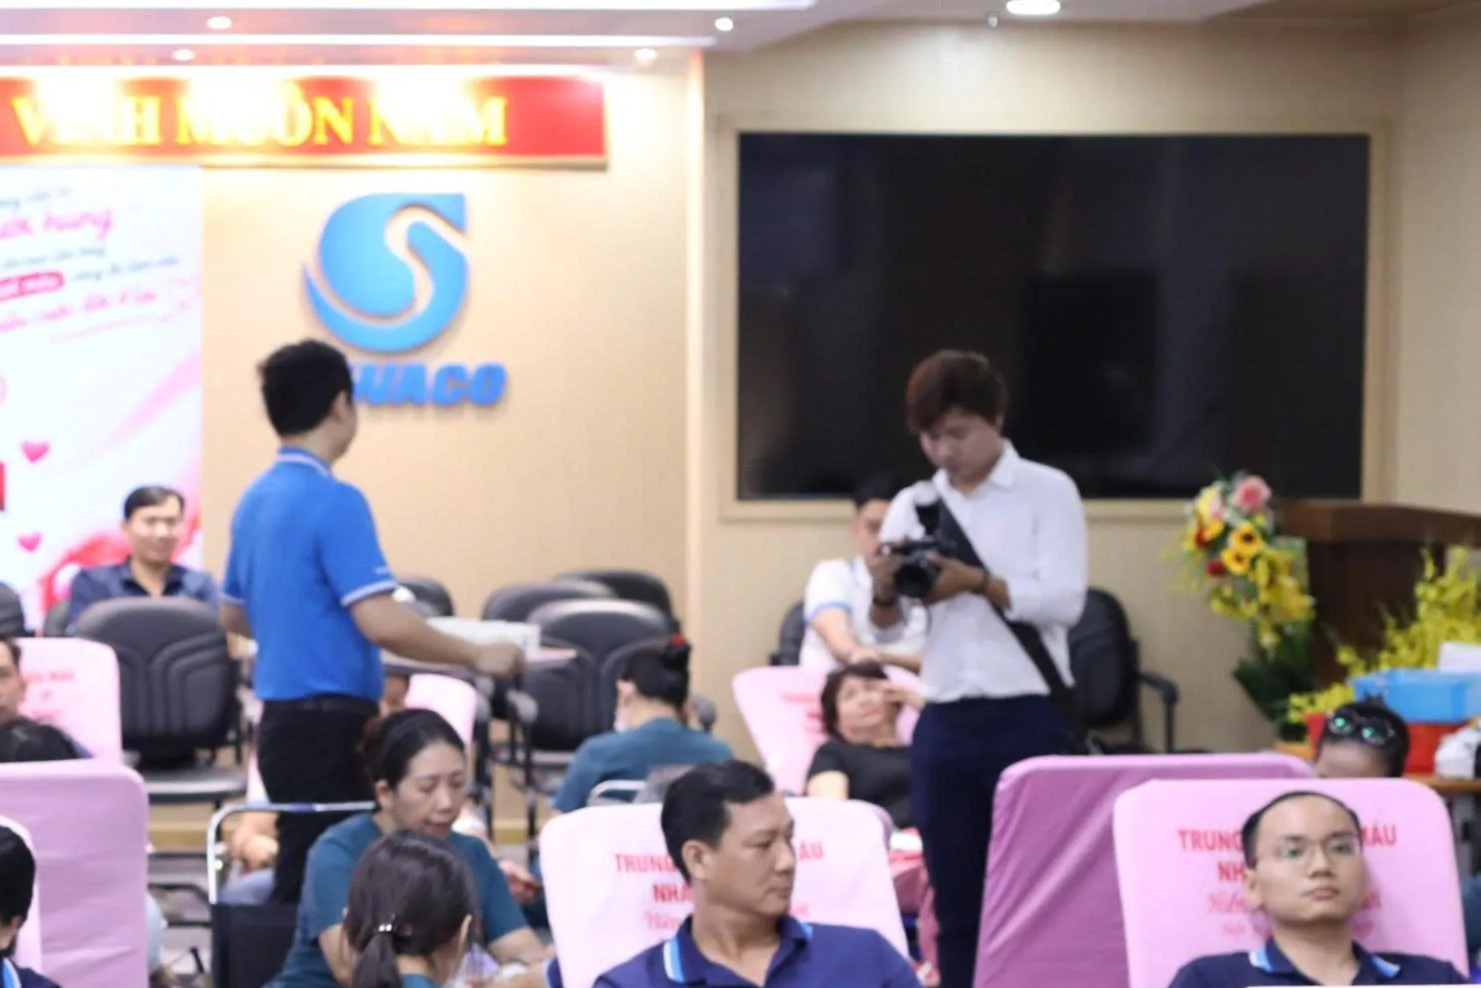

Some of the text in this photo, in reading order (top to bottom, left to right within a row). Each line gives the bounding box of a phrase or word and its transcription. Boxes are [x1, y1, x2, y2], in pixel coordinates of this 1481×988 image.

[11, 97, 162, 147] VH
[367, 97, 507, 147] NM
[352, 361, 507, 407] WACO
[1218, 861, 1245, 882] NH
